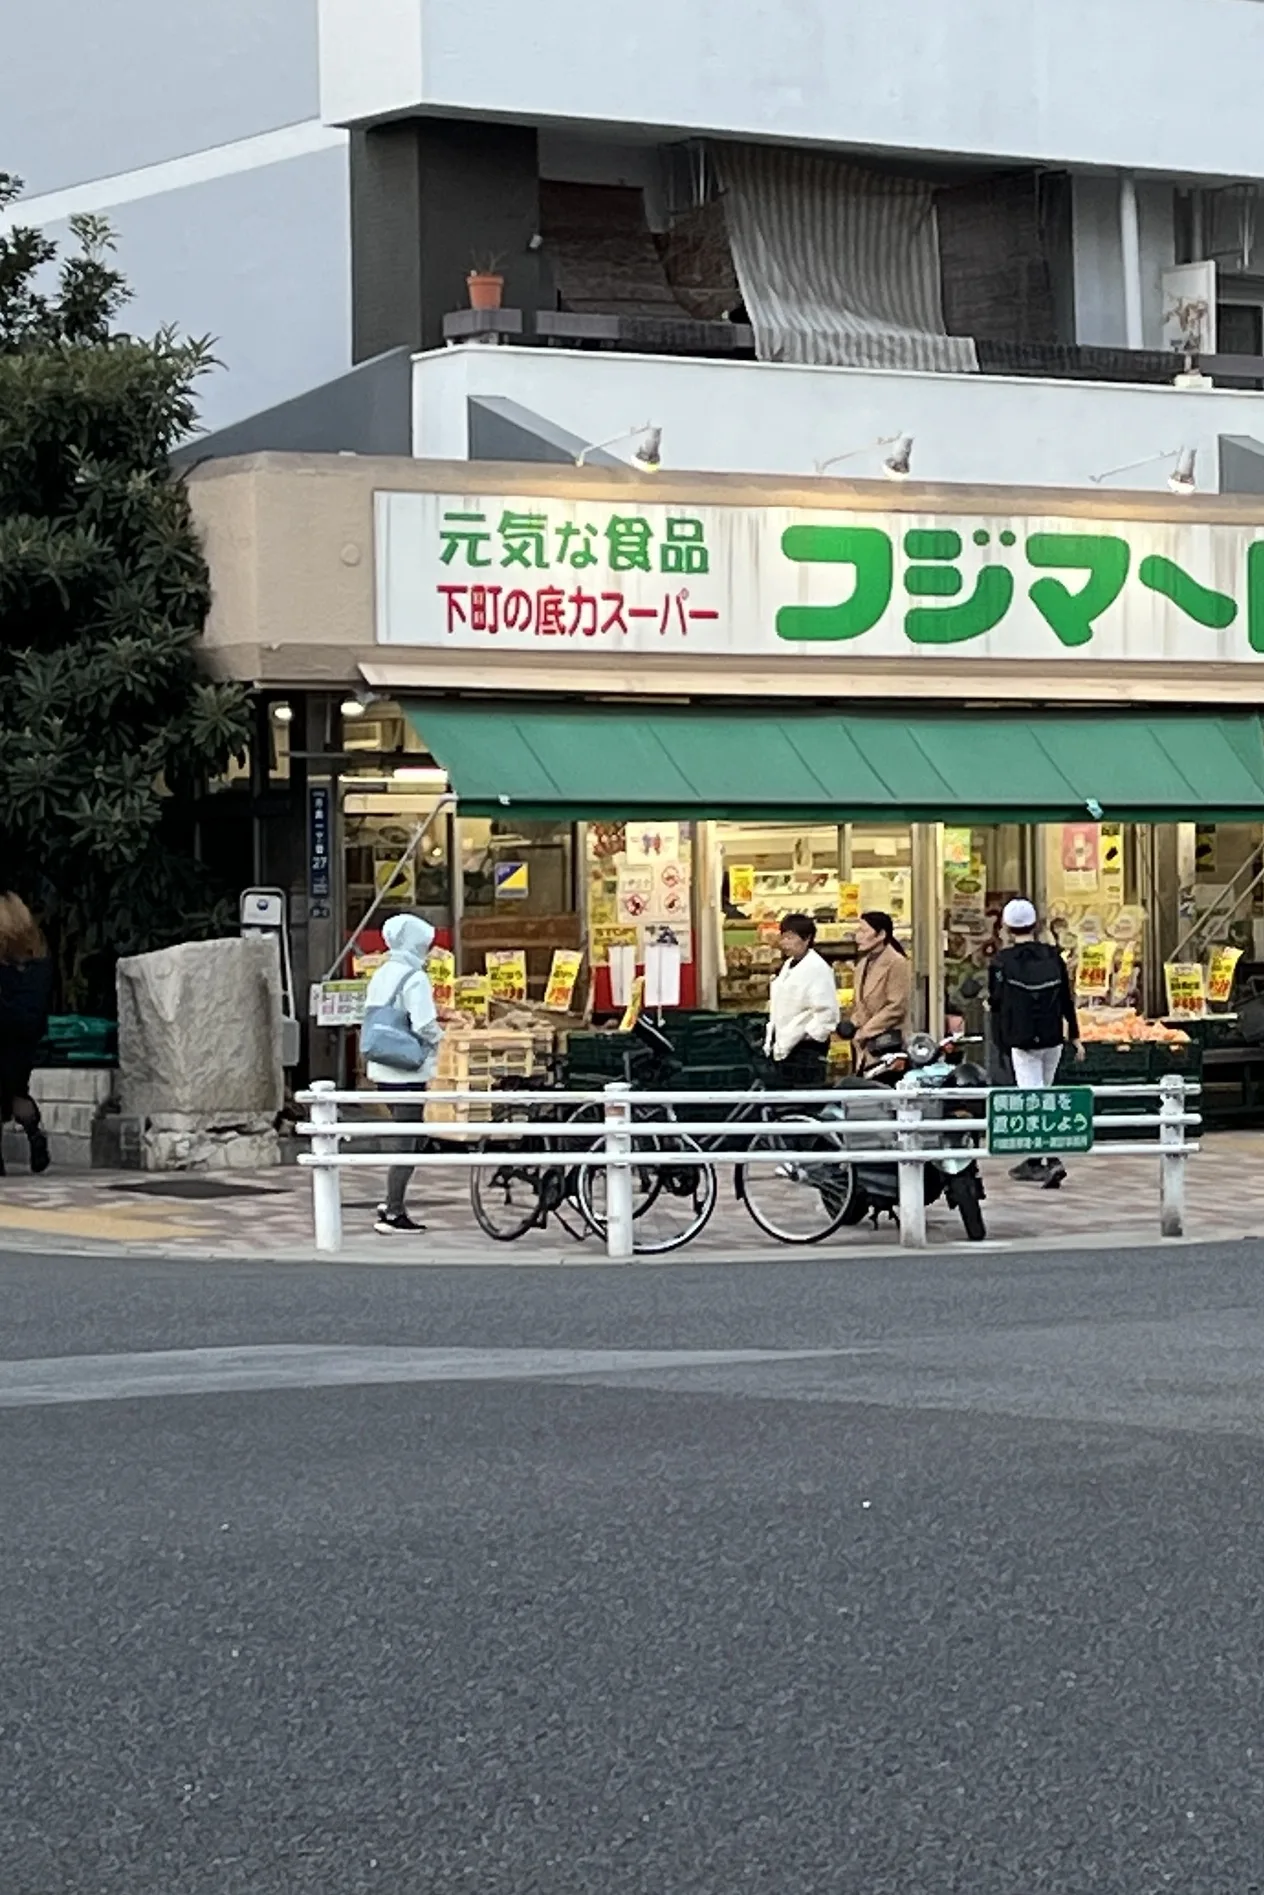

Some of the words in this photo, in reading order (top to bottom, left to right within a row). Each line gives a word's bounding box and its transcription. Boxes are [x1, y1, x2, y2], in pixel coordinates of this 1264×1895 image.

[439, 511, 711, 575] 元気な食品
[438, 584, 720, 637] 下町の底力スーパー
